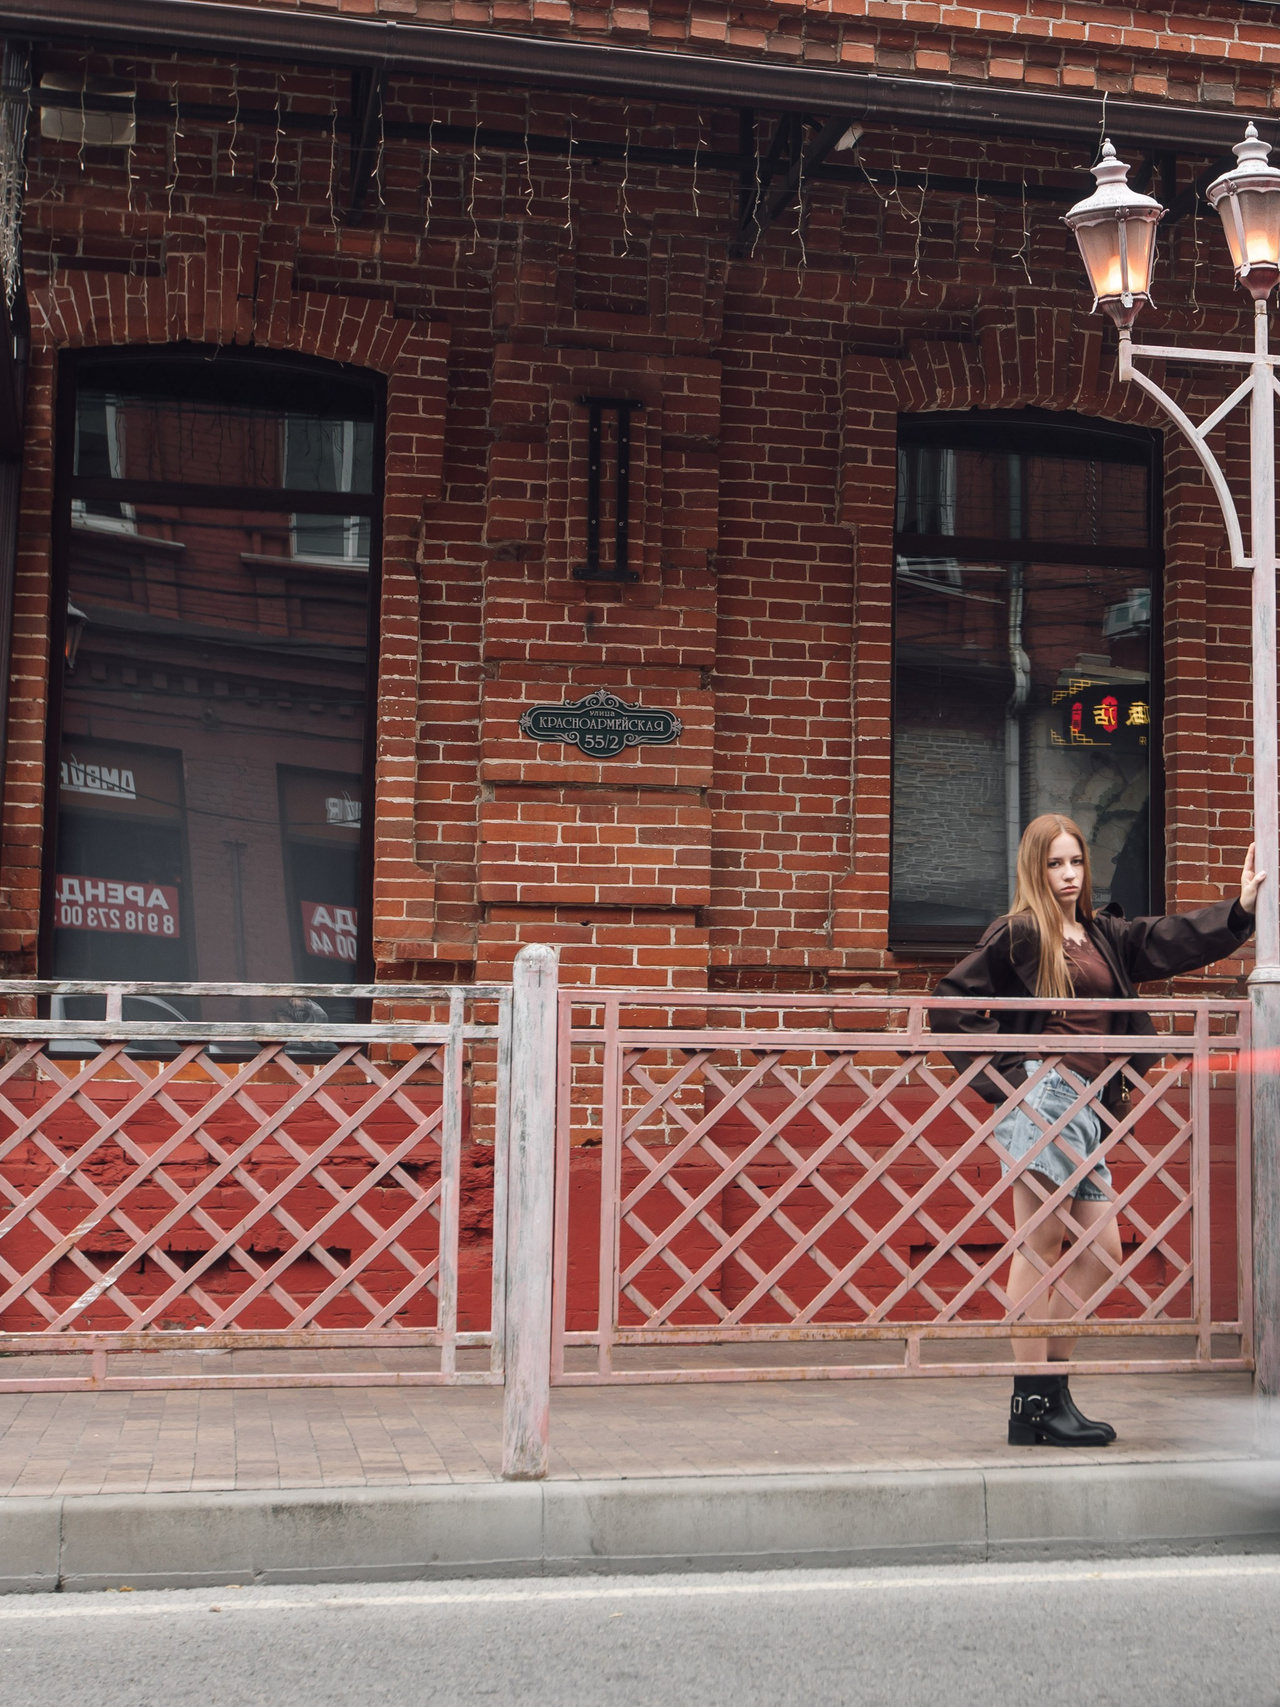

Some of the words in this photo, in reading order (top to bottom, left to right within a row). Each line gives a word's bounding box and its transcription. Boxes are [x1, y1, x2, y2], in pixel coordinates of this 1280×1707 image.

[589, 710, 616, 718] улица
[539, 716, 665, 732] КРАСНОАРМЕЙСКАЯ
[584, 734, 620, 749] 55/2
